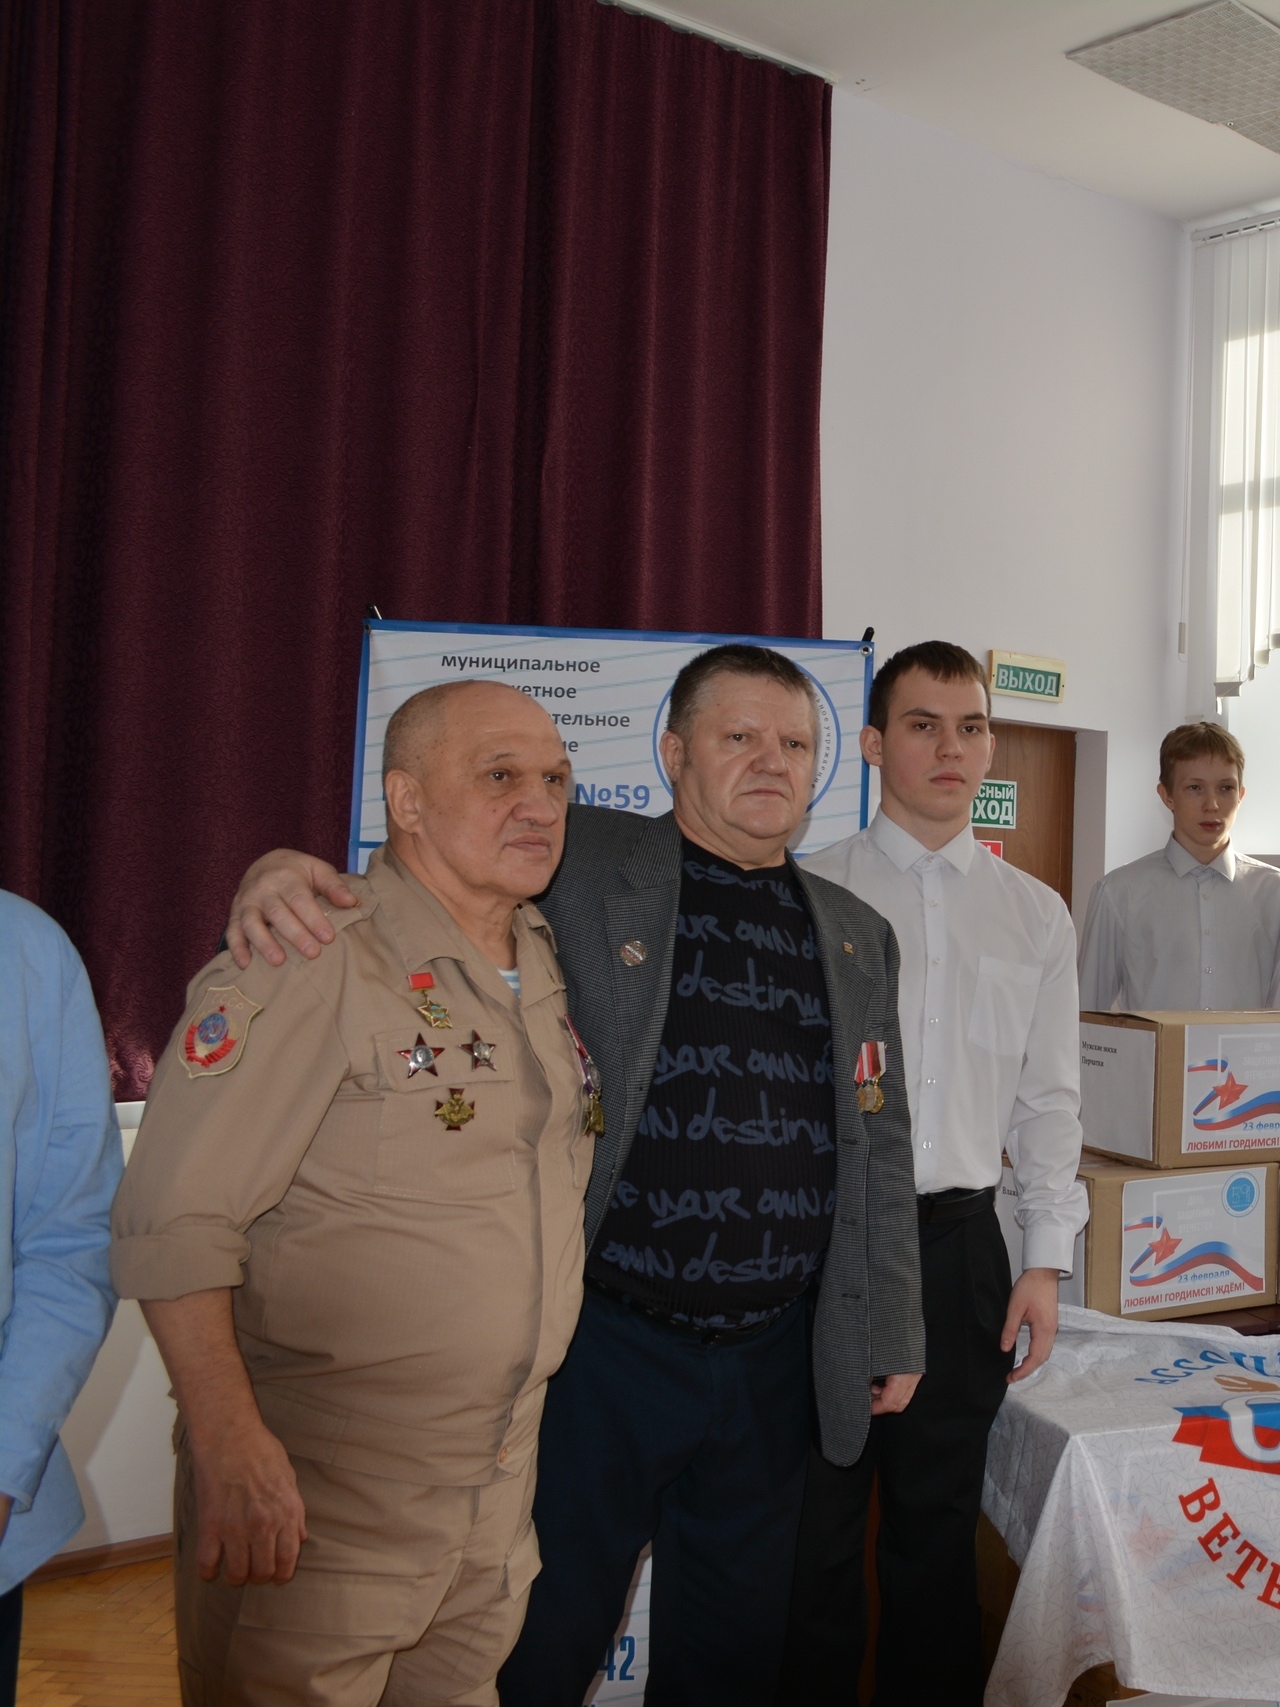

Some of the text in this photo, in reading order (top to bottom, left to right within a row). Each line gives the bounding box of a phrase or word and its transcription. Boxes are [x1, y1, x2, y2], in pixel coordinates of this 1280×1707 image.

[441, 655, 601, 674] муниципальное
[999, 668, 1058, 696] ВЫХОД
[512, 684, 577, 699] етное
[549, 712, 631, 729] тельное
[974, 783, 1014, 800] СНЫЙ
[971, 800, 1014, 825] ХОД
[676, 949, 831, 1027] destiny
[686, 1086, 835, 1155] destiny
[1242, 1121, 1255, 1132] 23
[1186, 1139, 1227, 1152] ЛЮБИМ!
[1229, 1136, 1280, 1150] ГОРДИМСЯ!
[1177, 1269, 1230, 1284] 23 февраля
[1123, 1282, 1245, 1309] ЛЮБИМ! ГОРДИМСЯ! ЖДЁМ!
